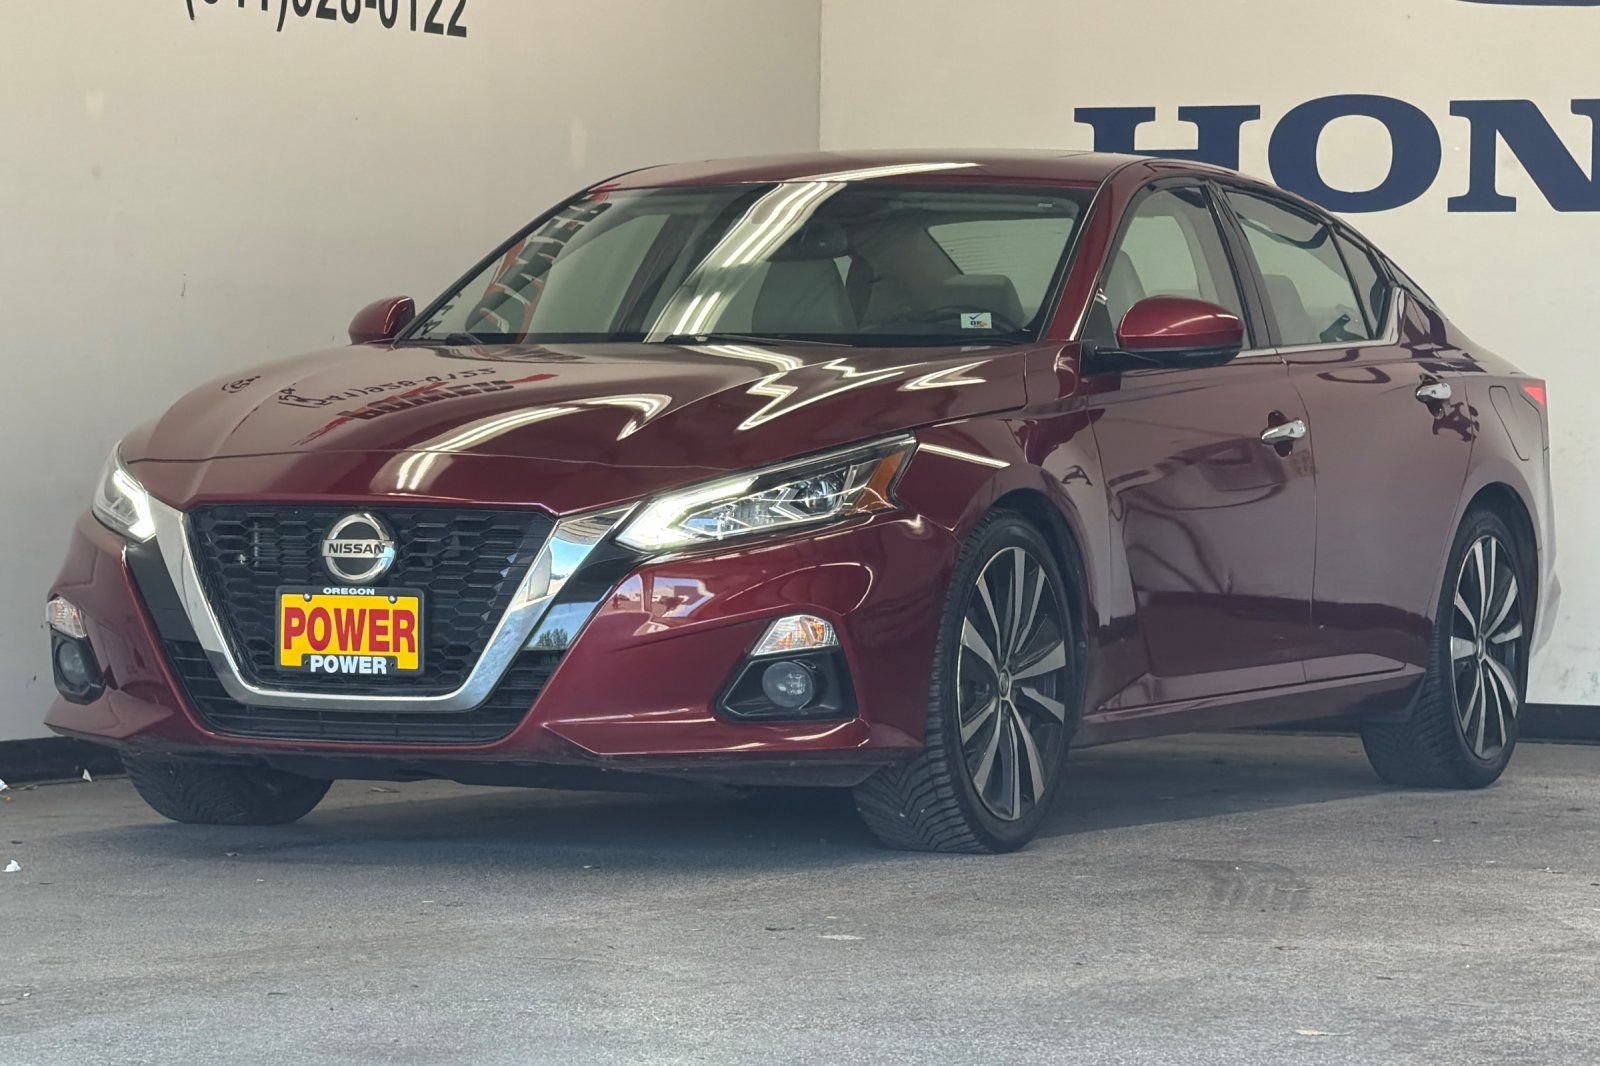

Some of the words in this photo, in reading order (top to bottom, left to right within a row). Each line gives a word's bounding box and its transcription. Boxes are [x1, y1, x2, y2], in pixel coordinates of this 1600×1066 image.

[328, 543, 385, 554] NISSAN
[322, 587, 375, 595] OREGON
[283, 606, 416, 653] POWER
[310, 655, 387, 675] POWER
